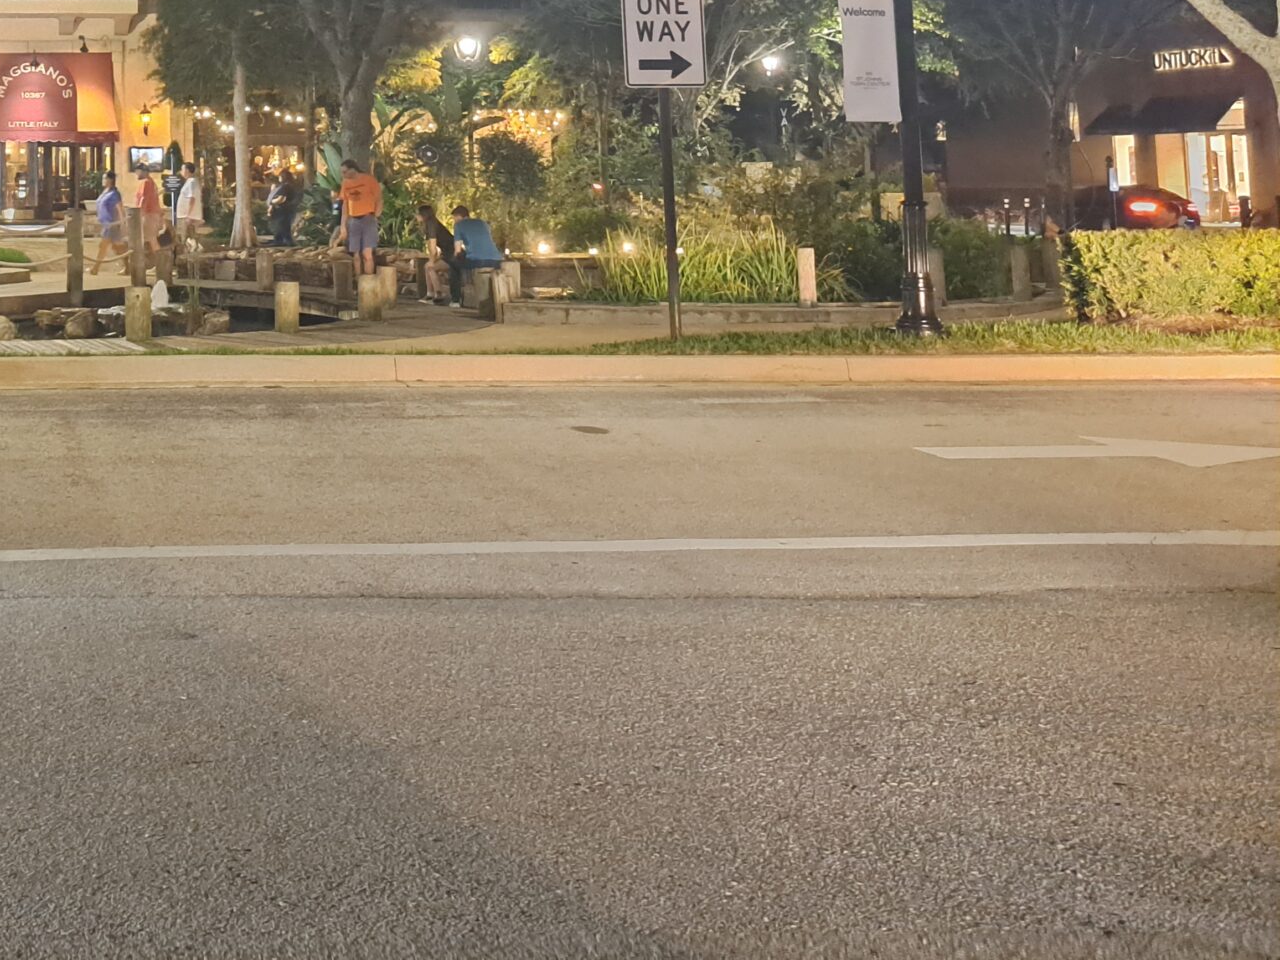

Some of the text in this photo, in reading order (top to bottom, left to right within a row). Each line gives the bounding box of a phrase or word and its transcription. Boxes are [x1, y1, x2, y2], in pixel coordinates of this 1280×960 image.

[842, 7, 886, 17] Welcome
[636, 21, 690, 42] WAY
[7, 121, 59, 129] LITTLE ITALY
